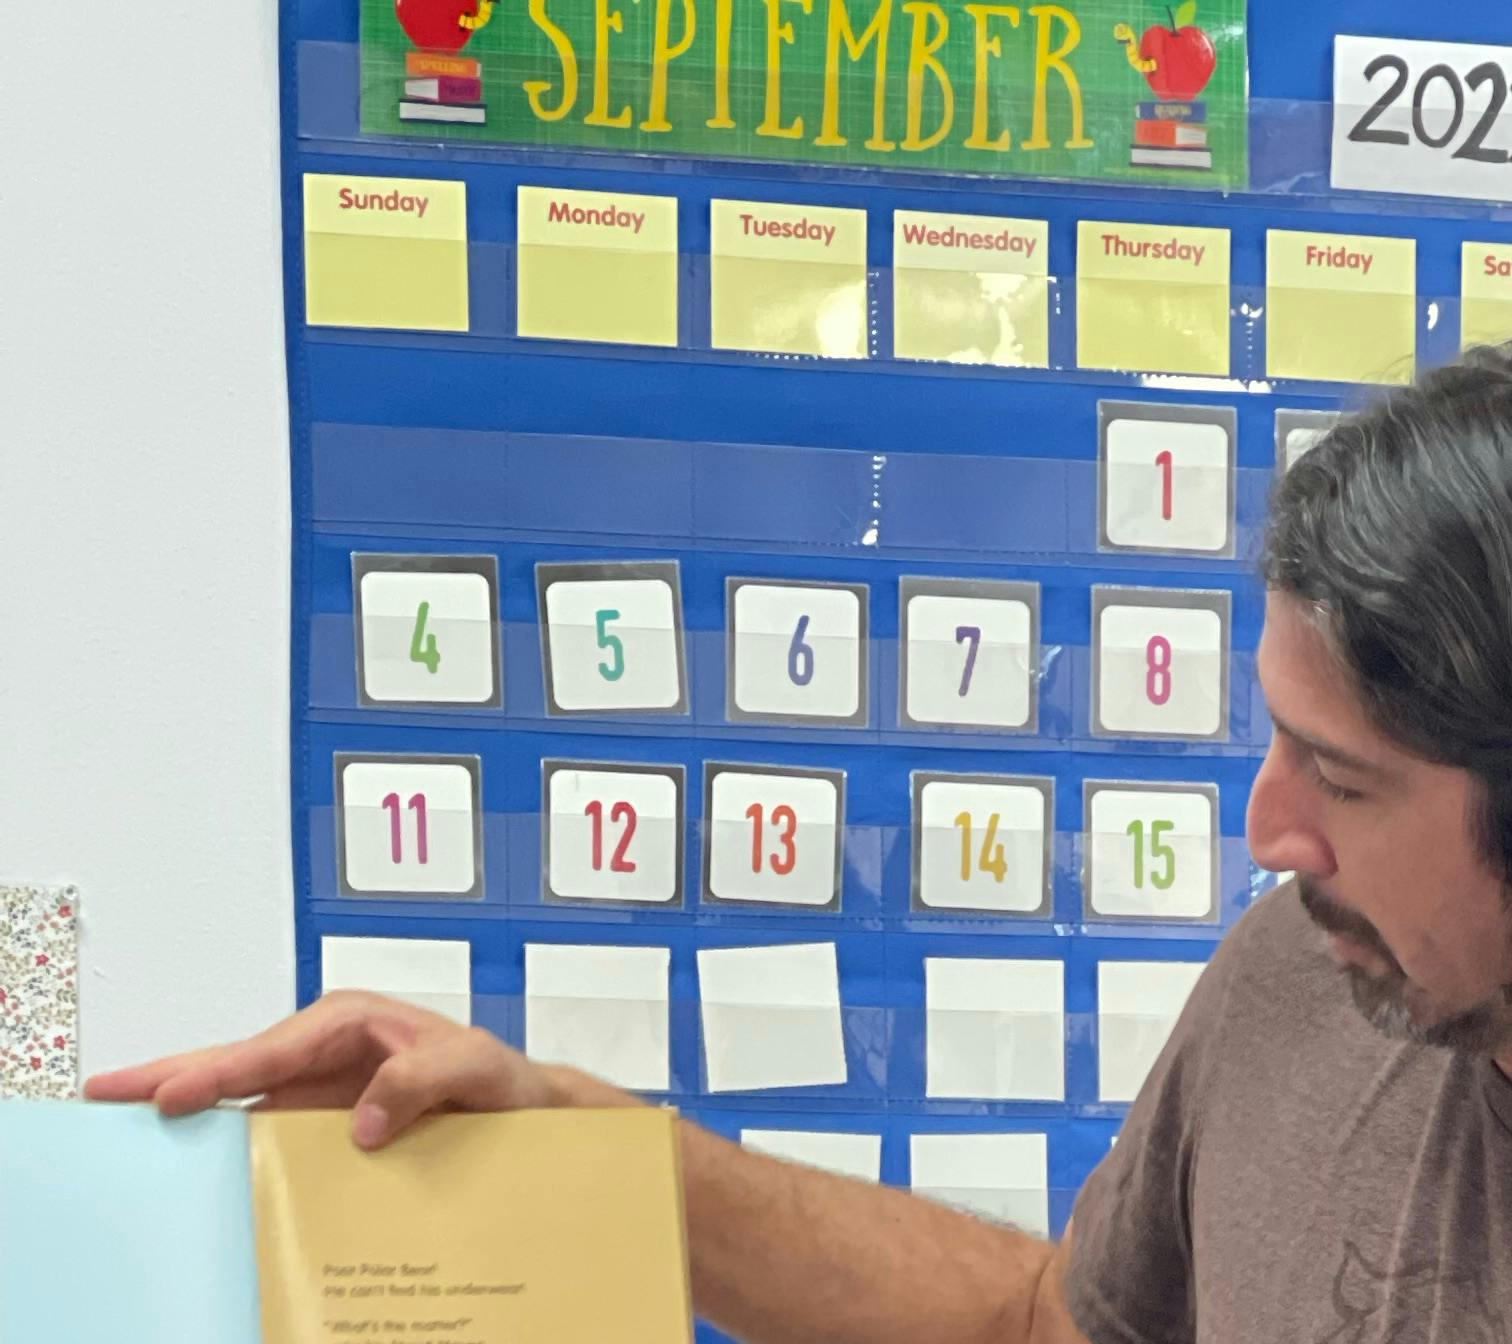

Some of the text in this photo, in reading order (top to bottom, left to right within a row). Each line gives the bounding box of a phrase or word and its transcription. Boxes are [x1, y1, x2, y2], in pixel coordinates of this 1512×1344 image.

[522, 0, 1093, 153] SEPTEMBER
[338, 187, 430, 219] Sunday
[548, 201, 645, 232] Monday
[740, 213, 837, 246] Tuesday
[902, 223, 1037, 258] Wednesday
[1100, 234, 1206, 265] Thursday
[1305, 245, 1374, 275] Friday
[1154, 449, 1174, 521] 1
[408, 601, 442, 674] 4
[595, 608, 625, 682] 5
[786, 615, 815, 687] 6
[953, 625, 982, 696] 7
[1145, 634, 1173, 706] 8
[381, 792, 428, 866] 11
[584, 800, 638, 874] 12
[744, 802, 798, 876] 13
[953, 810, 1008, 884] 14
[1126, 819, 1176, 890] 15
